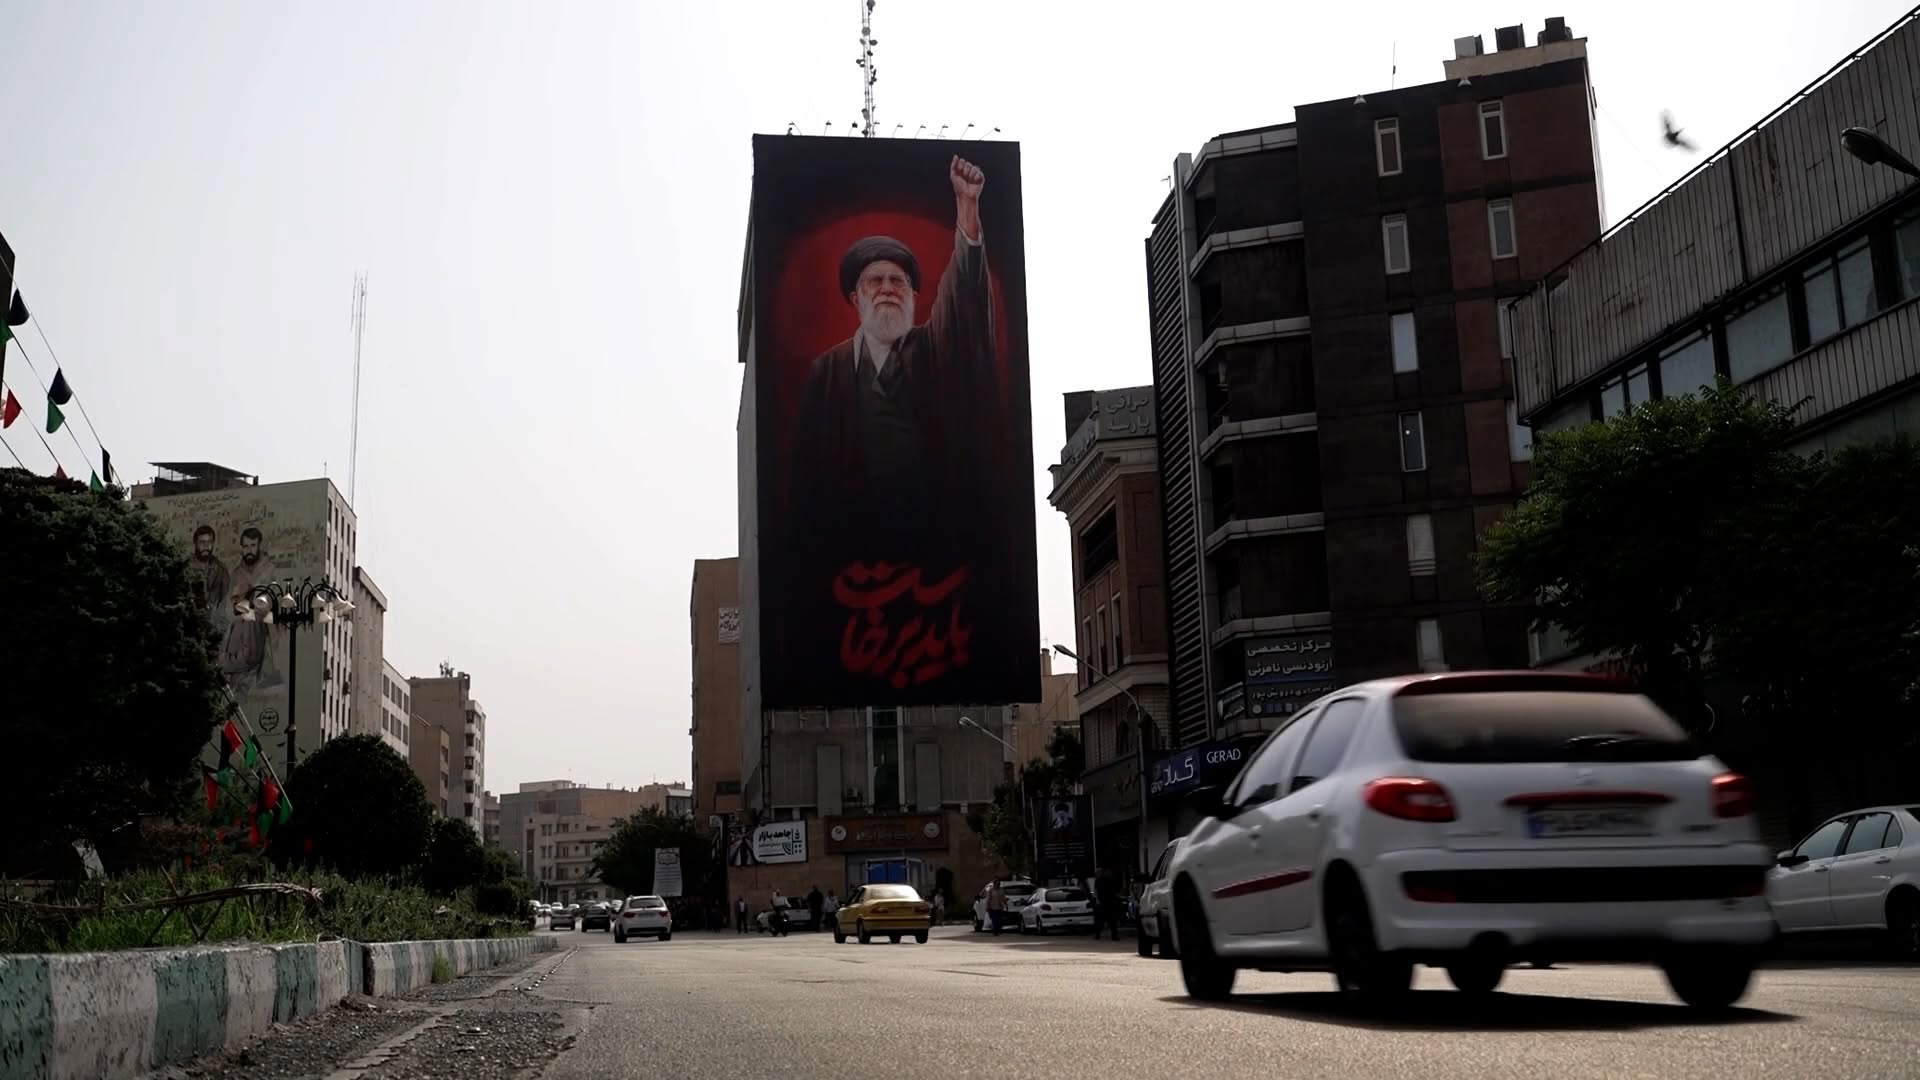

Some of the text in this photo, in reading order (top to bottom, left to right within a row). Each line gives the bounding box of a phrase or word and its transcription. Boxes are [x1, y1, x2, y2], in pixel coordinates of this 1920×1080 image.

[1247, 639, 1331, 657] مرکز تخصصی
[1206, 748, 1241, 764] GERAD
